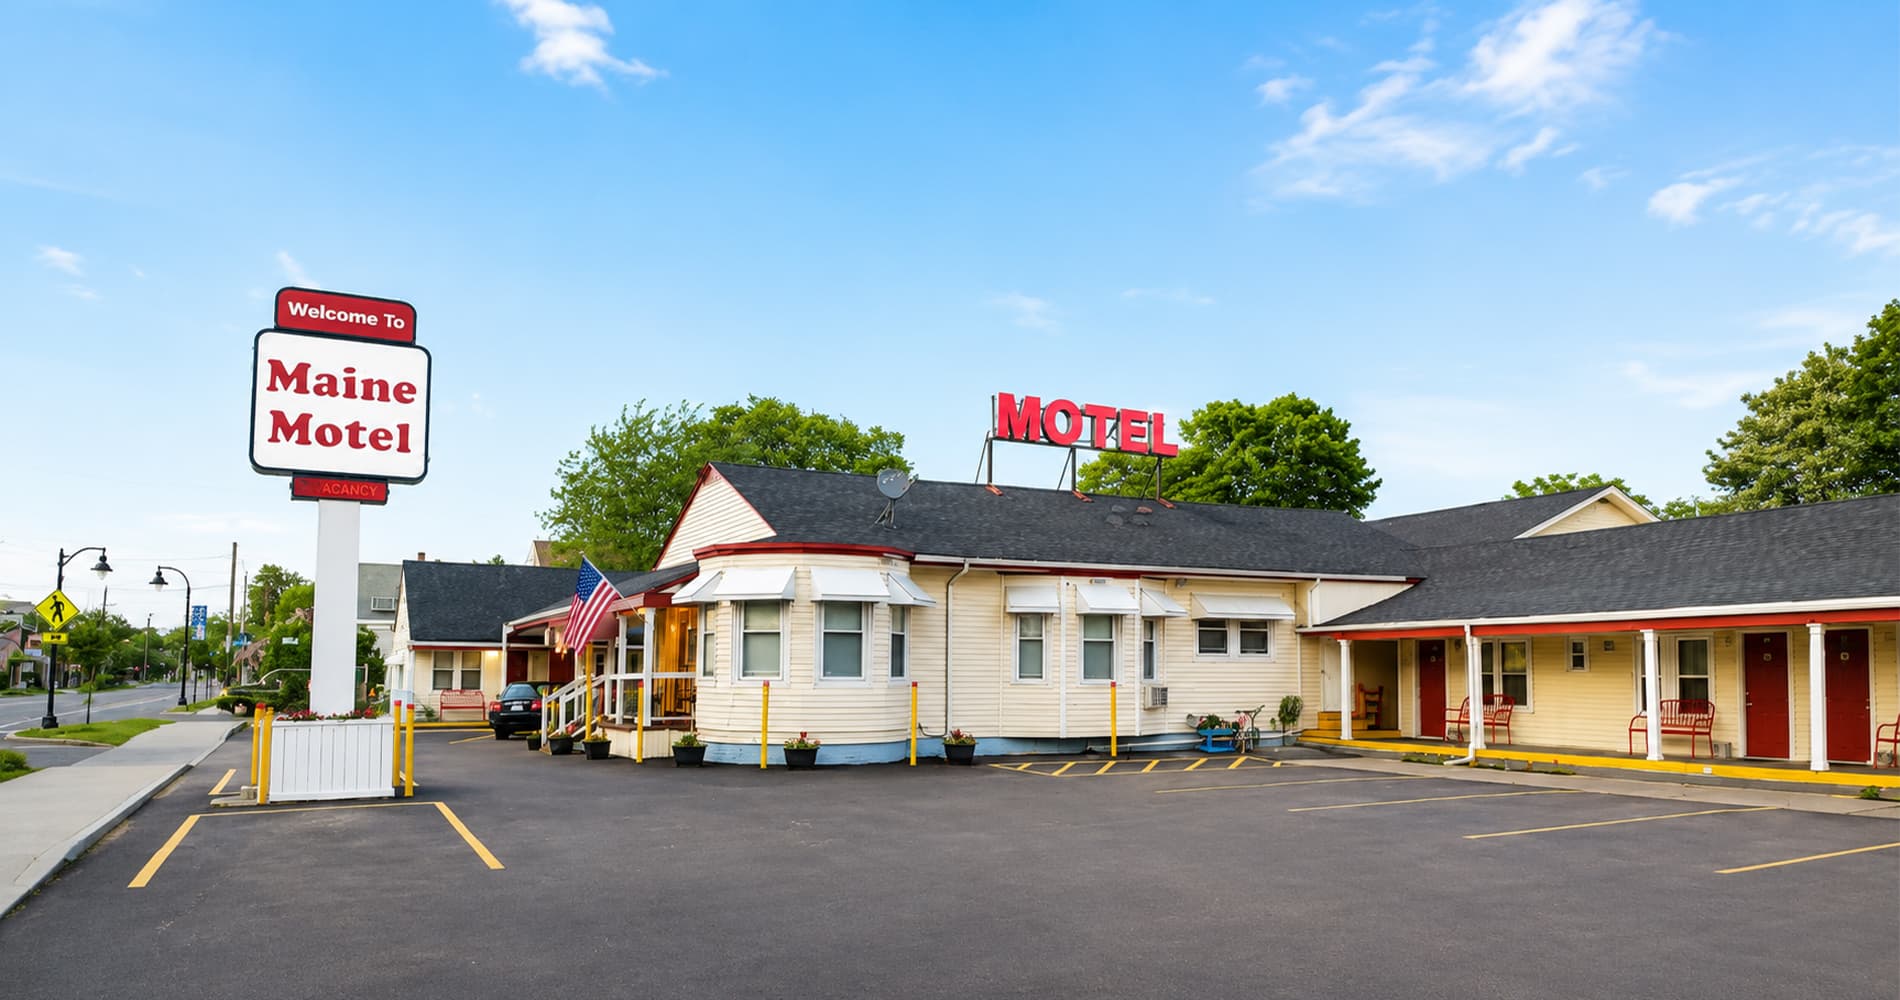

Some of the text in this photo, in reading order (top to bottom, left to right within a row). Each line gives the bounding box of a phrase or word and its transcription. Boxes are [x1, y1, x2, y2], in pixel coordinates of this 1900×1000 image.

[288, 301, 405, 329] Welcome To
[266, 359, 417, 404] Maine
[267, 410, 411, 453] Motel
[997, 392, 1178, 456] MOTEL
